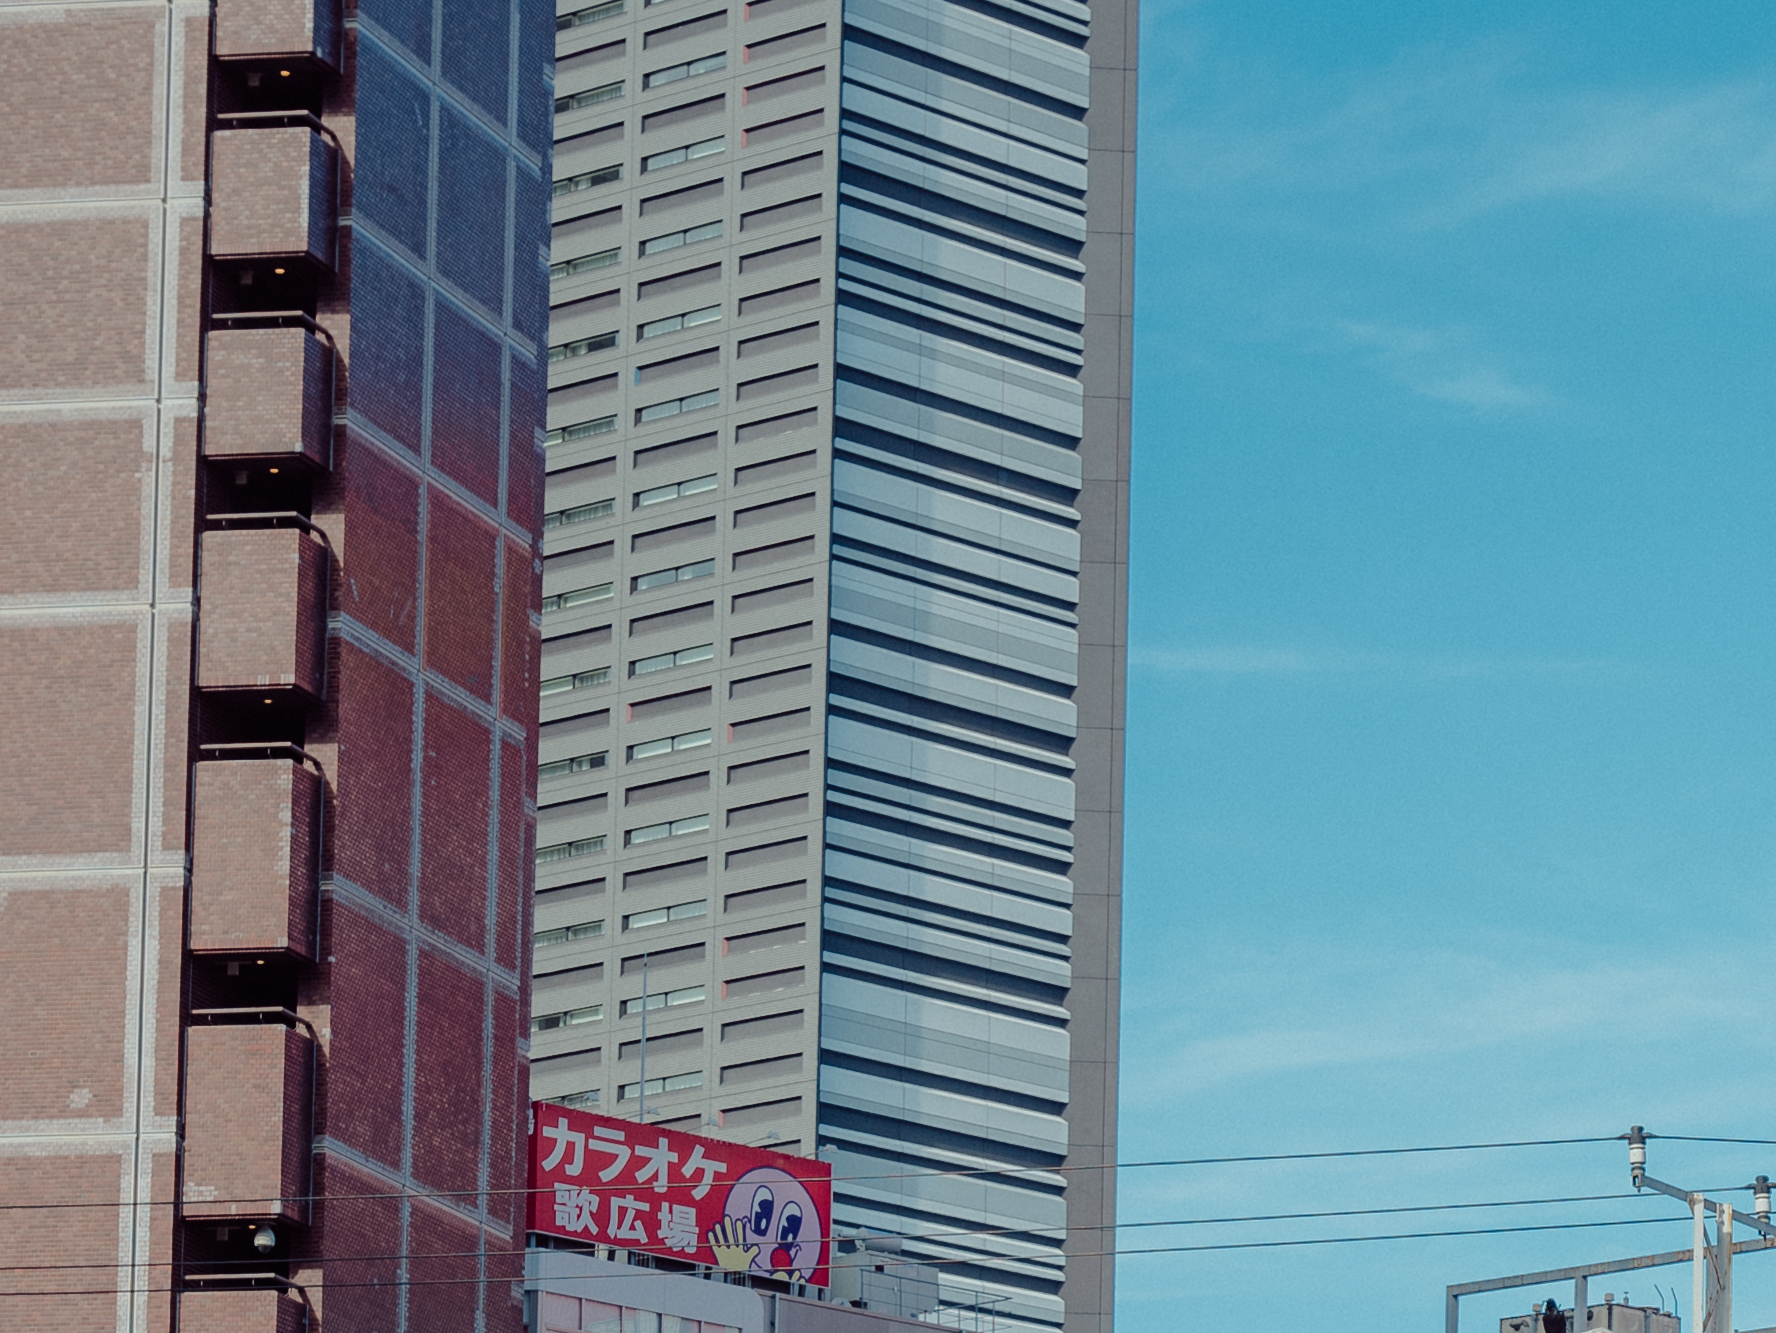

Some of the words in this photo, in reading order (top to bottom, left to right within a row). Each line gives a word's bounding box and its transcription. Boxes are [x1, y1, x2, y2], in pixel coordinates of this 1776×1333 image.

[540, 1118, 727, 1201] カラオケ
[553, 1182, 698, 1254] 歌広場
